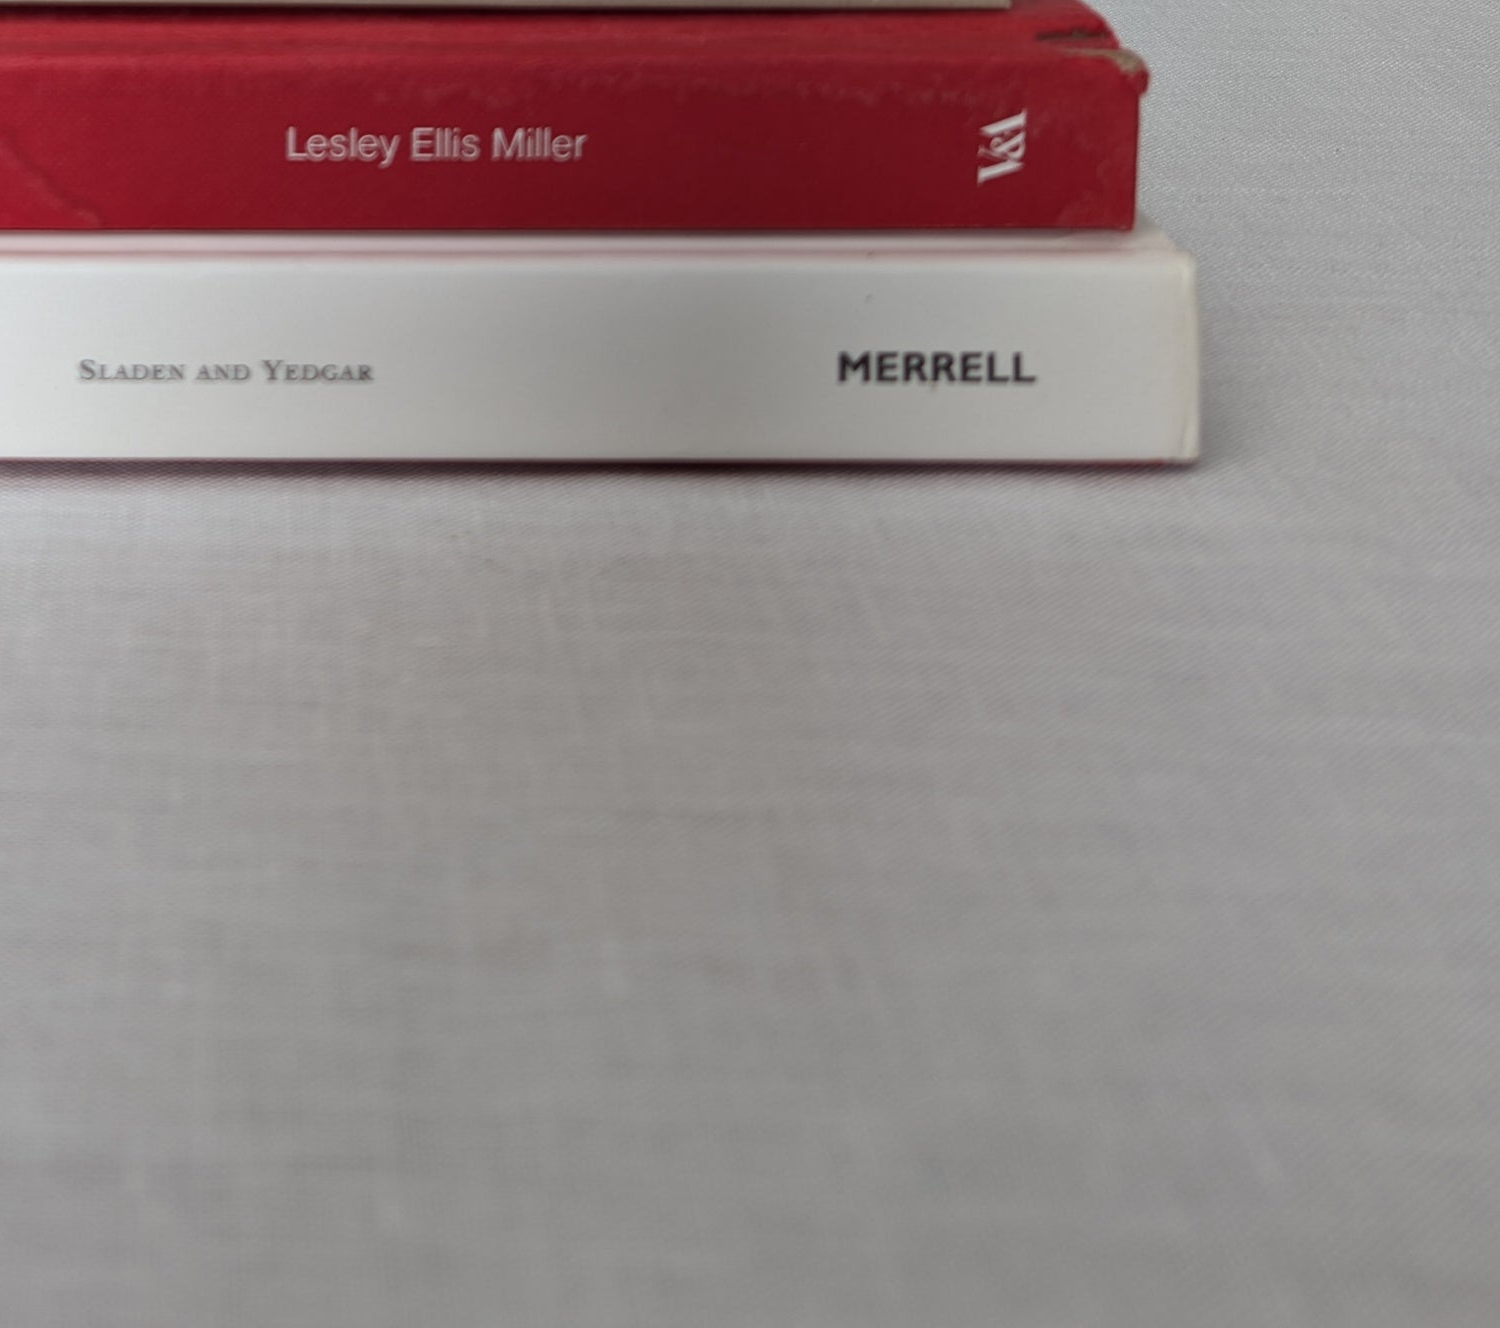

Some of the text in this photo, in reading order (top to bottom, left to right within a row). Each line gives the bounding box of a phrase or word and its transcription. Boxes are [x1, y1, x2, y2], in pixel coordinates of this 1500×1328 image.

[286, 126, 588, 169] Lesley Ellis Miller
[978, 110, 1027, 186] V&A
[838, 351, 1037, 383] MERRELL
